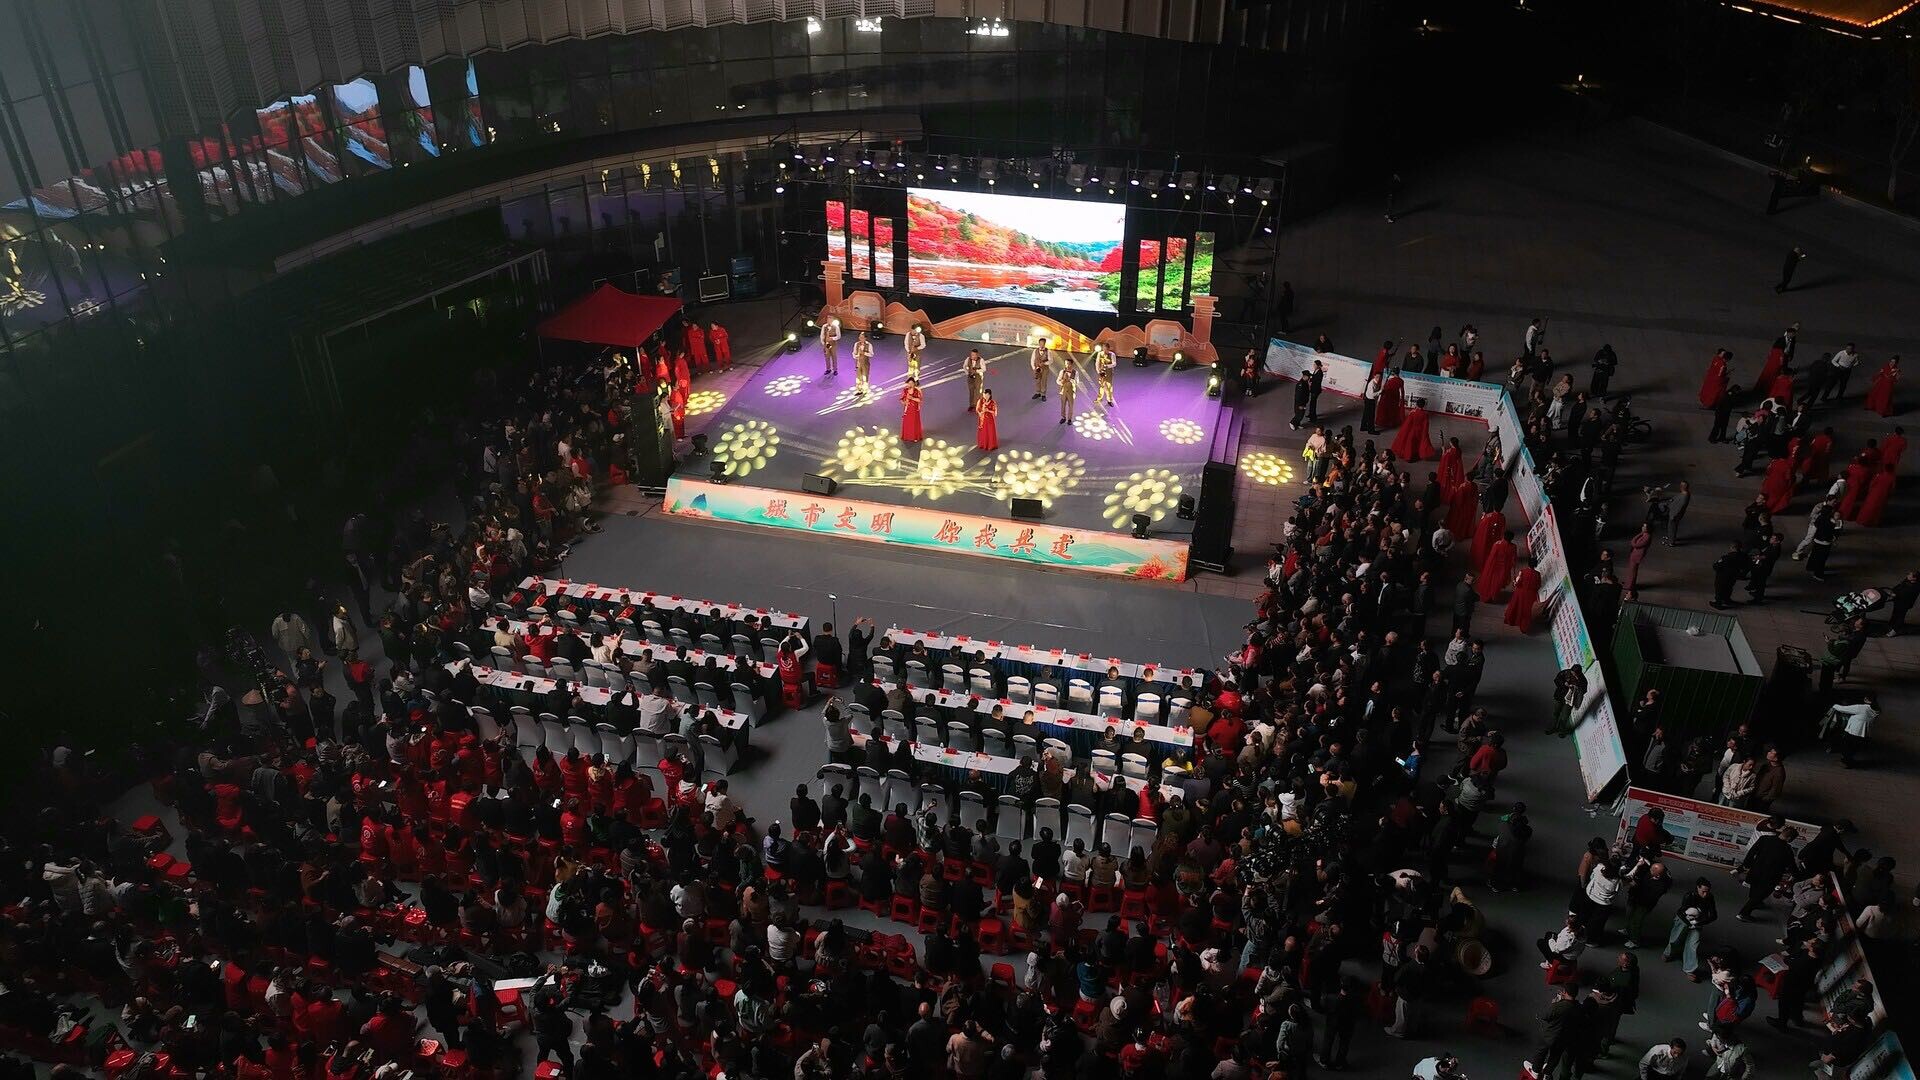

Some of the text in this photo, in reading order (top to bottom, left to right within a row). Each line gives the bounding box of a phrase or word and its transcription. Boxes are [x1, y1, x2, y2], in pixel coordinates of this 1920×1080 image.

[764, 499, 1074, 560] 城市文明 你我共建
